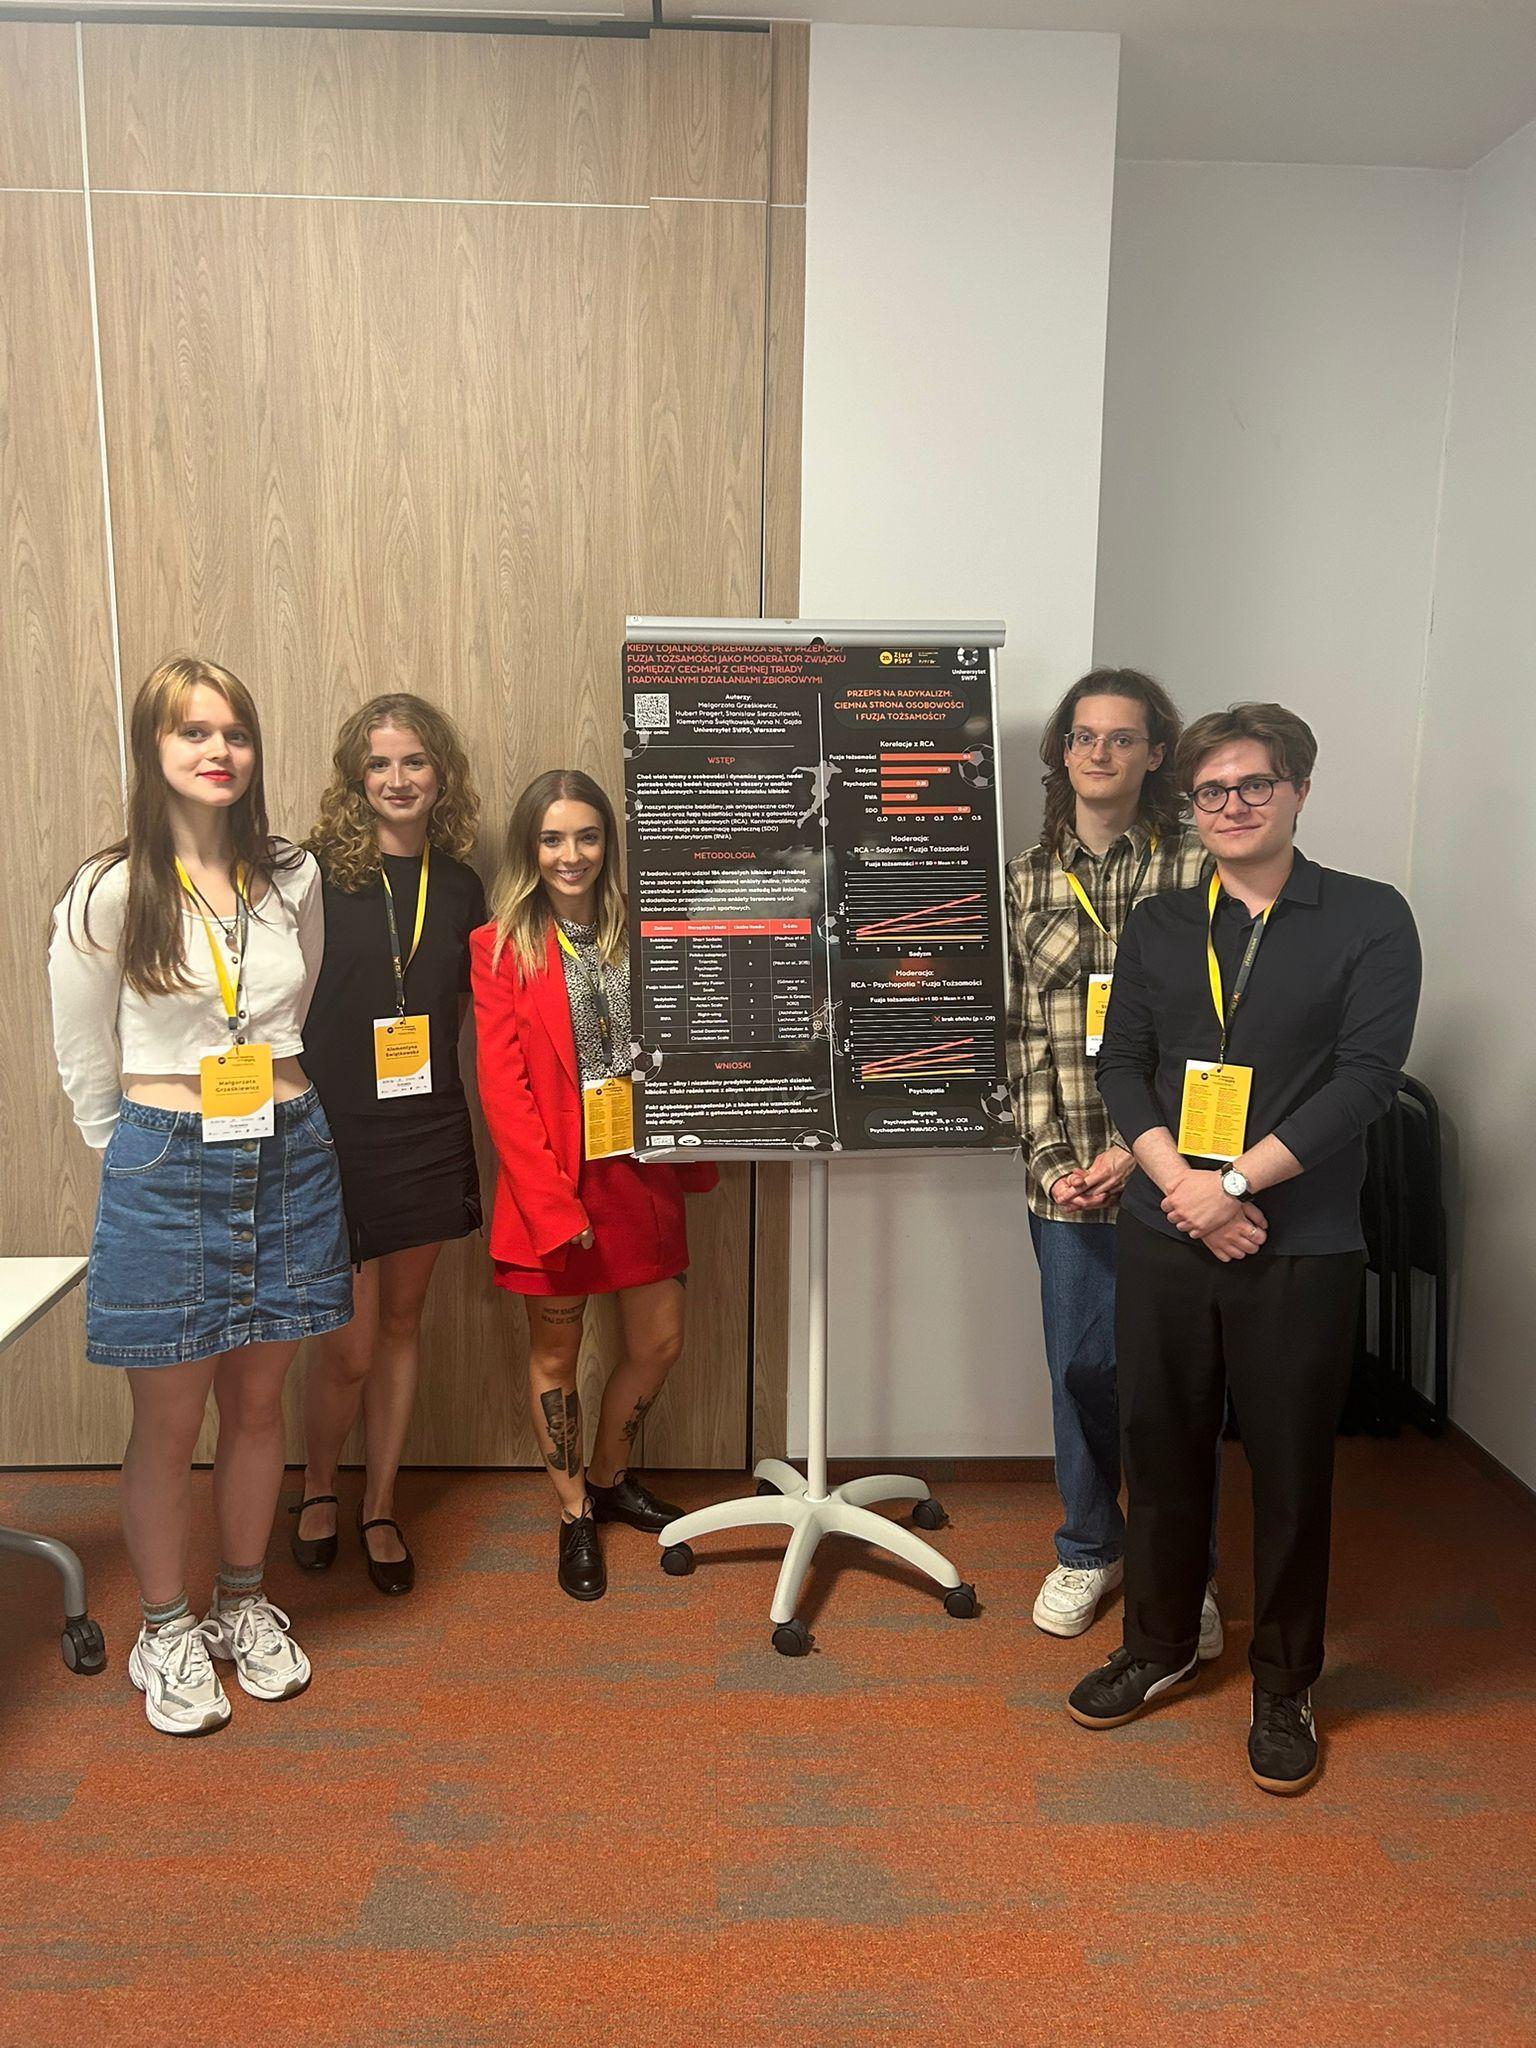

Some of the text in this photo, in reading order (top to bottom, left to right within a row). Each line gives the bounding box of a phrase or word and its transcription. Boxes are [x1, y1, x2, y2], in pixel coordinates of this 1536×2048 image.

[626, 644, 654, 652] KIEDY
[627, 655, 654, 664] FUZJA
[656, 653, 717, 662] TOŻSAMOŚCI
[718, 655, 741, 664] JAKO
[805, 655, 846, 665] ZWIĄZKU
[627, 665, 675, 674] POMIĘDZY
[730, 665, 768, 675] CIEMNEJ
[763, 676, 823, 684] ZBIOROWYMI
[906, 700, 964, 709] OSOBOWOŚCI
[860, 713, 885, 721] FUZJA
[887, 712, 946, 720] TOŻSAMOŚCI?
